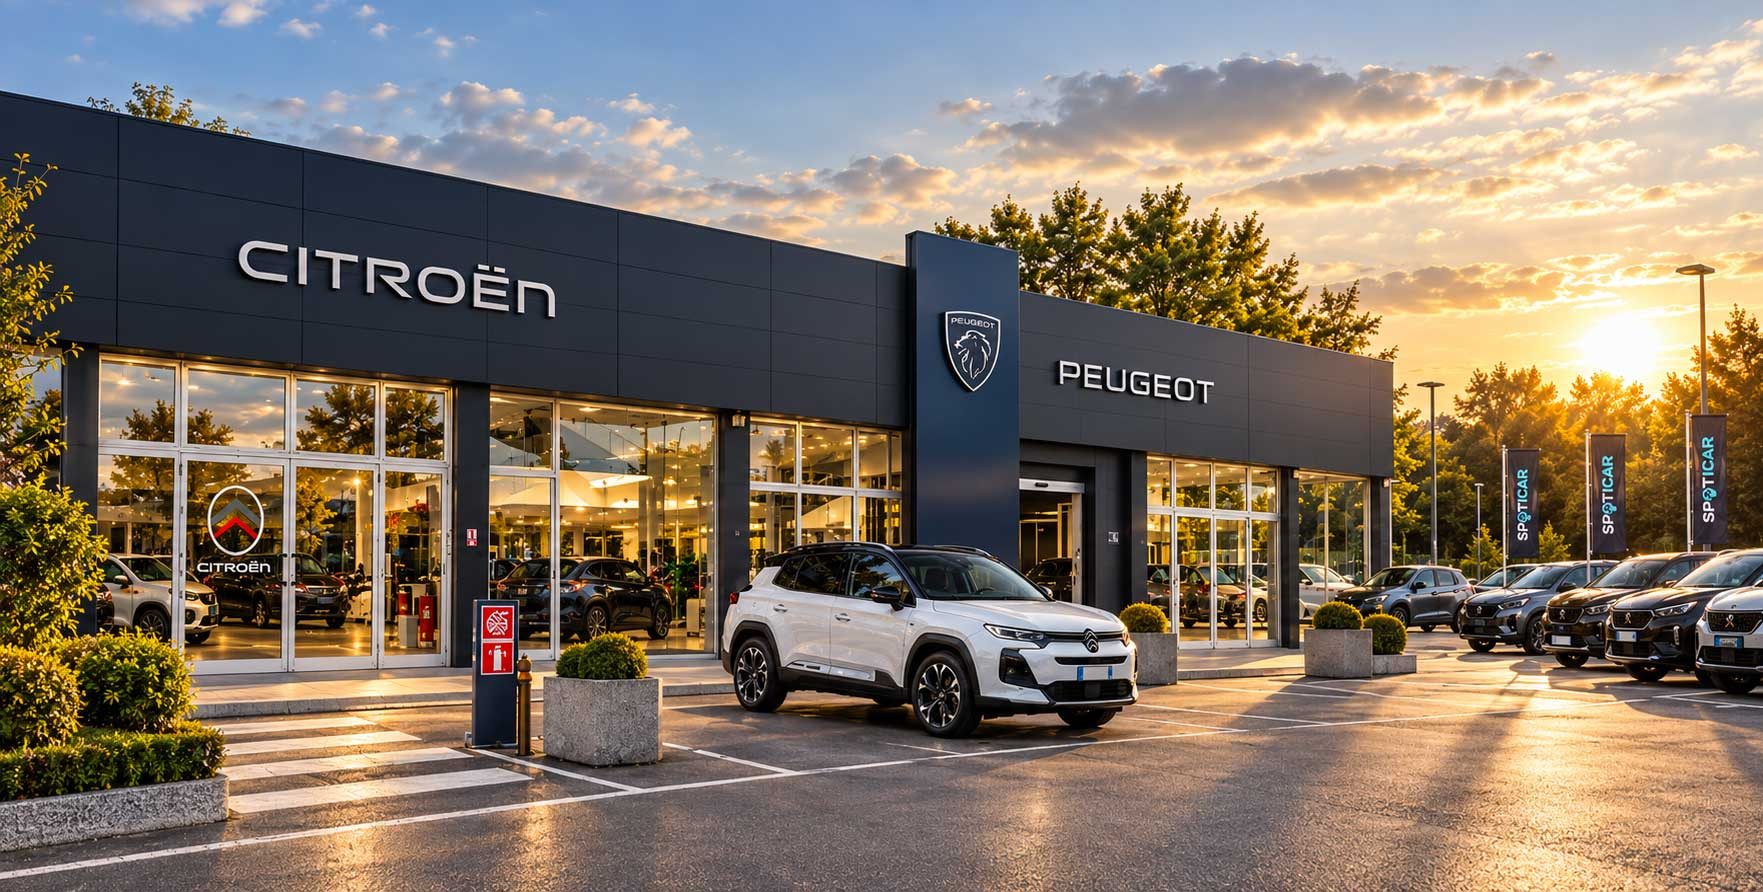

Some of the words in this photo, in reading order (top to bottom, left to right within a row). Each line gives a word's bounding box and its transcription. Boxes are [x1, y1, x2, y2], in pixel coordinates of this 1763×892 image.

[951, 317, 996, 329] PEUGEOT
[1059, 360, 1215, 404] PEUGEOT
[1517, 469, 1531, 541] SPOTICAR
[1602, 455, 1617, 535] SPOTICAR
[1702, 436, 1717, 523] SPOTICAR
